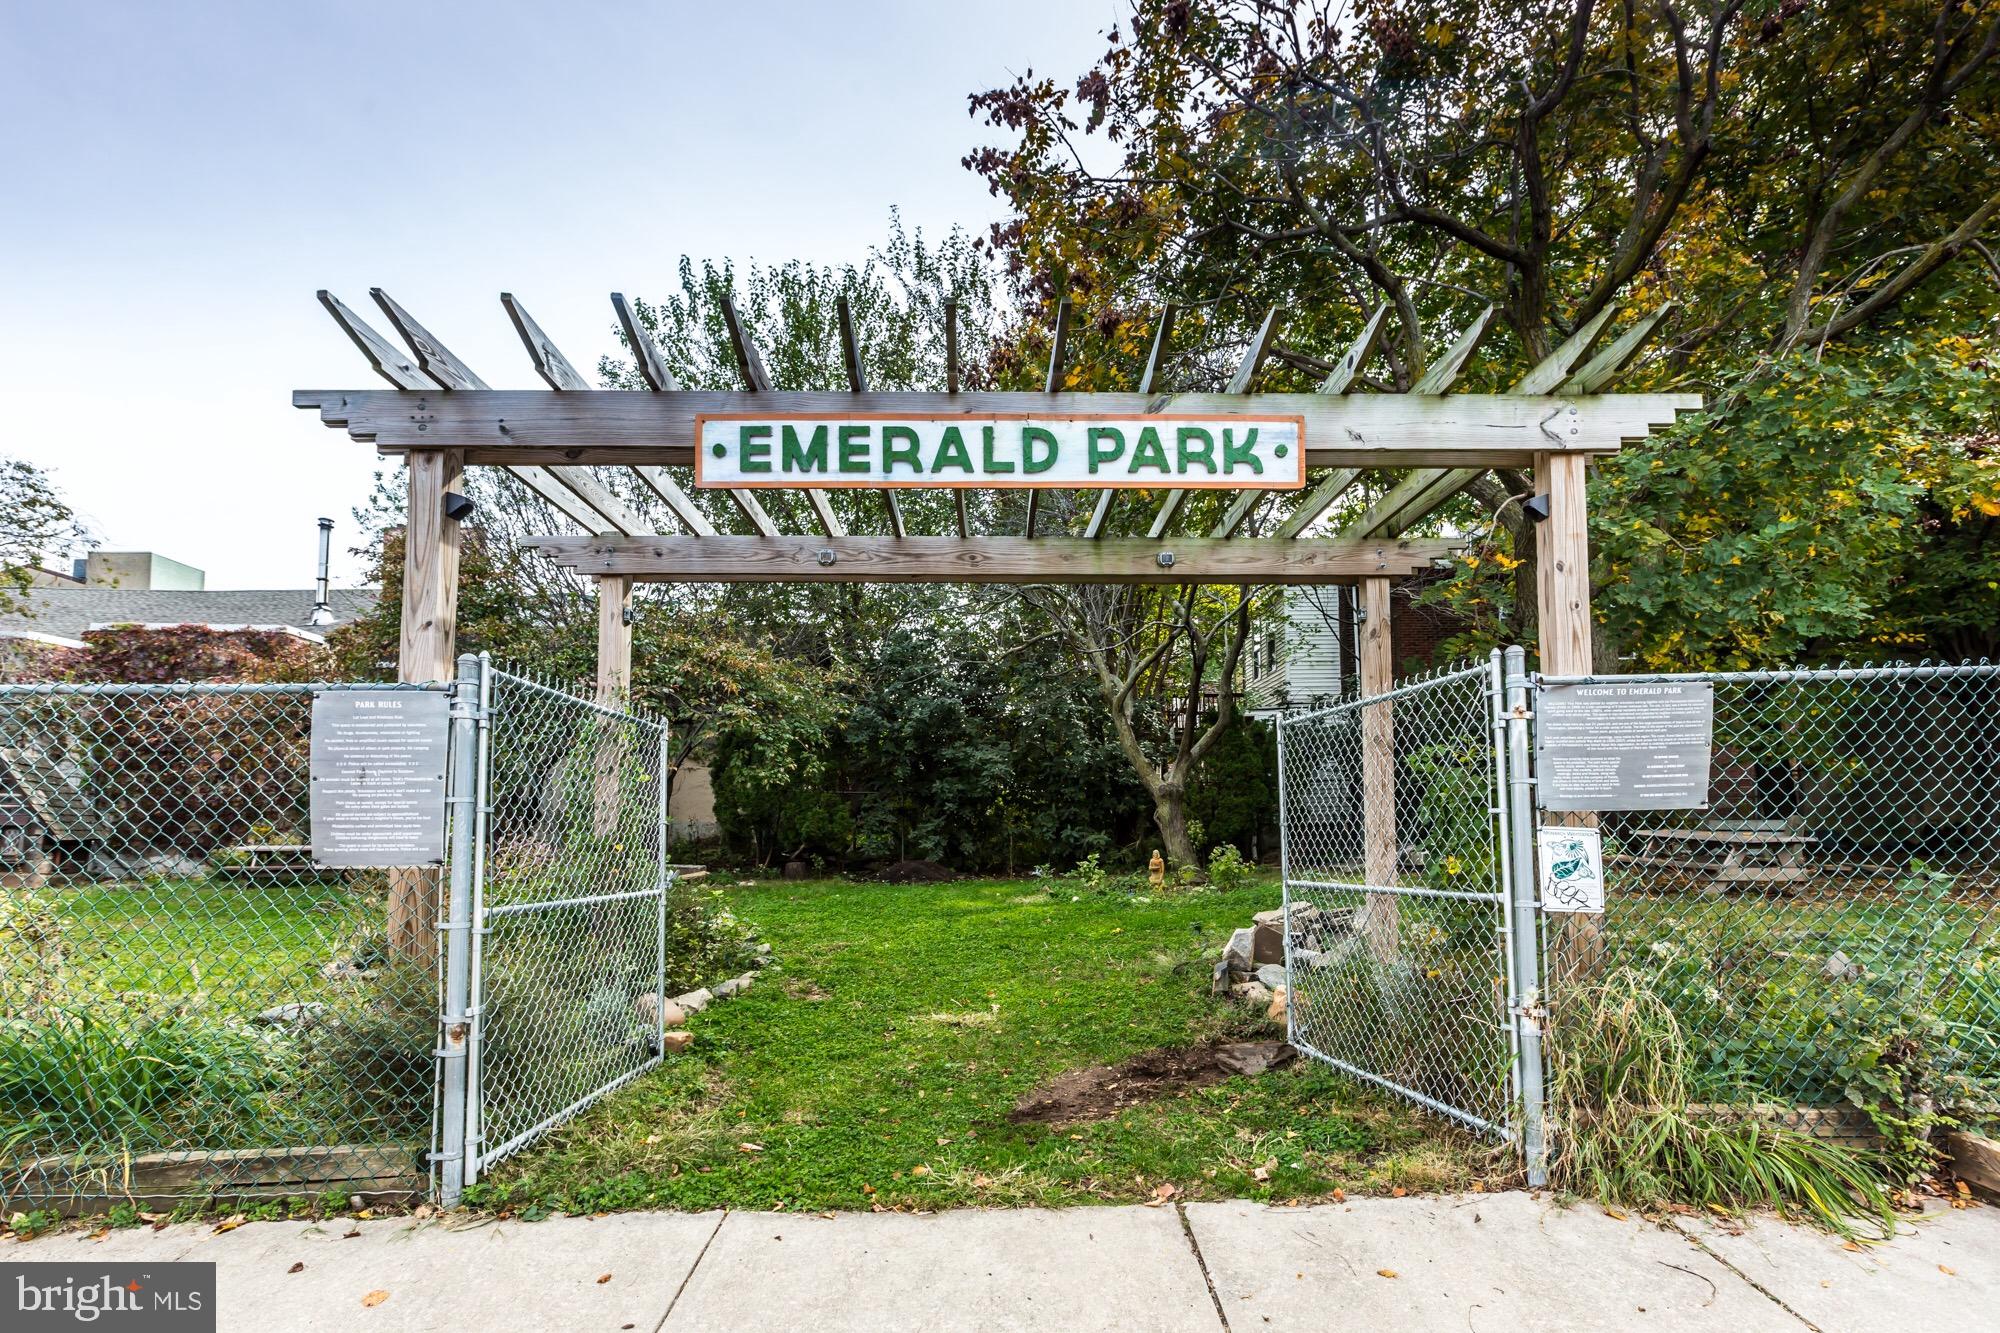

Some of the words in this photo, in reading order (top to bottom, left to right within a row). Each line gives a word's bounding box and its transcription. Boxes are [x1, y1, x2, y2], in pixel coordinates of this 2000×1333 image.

[739, 425, 1059, 474] EMERALD
[1088, 426, 1264, 474] PARK
[1576, 688, 1614, 697] WELCOME
[1616, 688, 1627, 696] TO
[1629, 687, 1662, 696] EMERALD
[1663, 687, 1682, 695] PARK
